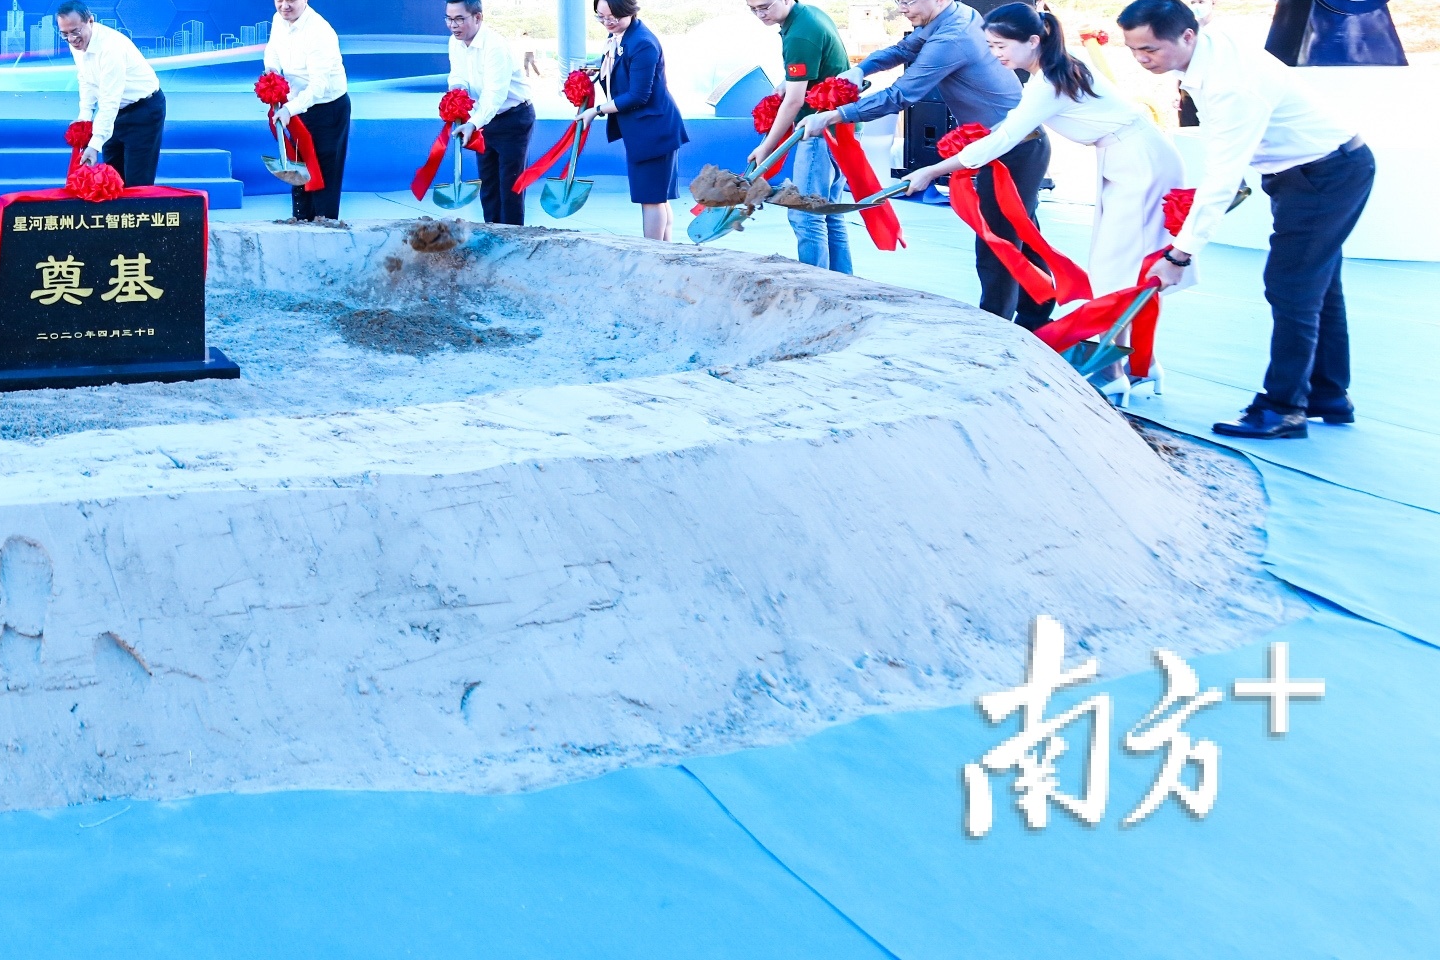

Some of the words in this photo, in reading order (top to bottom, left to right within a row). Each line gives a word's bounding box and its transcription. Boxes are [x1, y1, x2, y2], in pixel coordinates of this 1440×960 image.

[12, 211, 180, 232] 星河惠州人工智能产业园
[30, 251, 164, 306] 奠基
